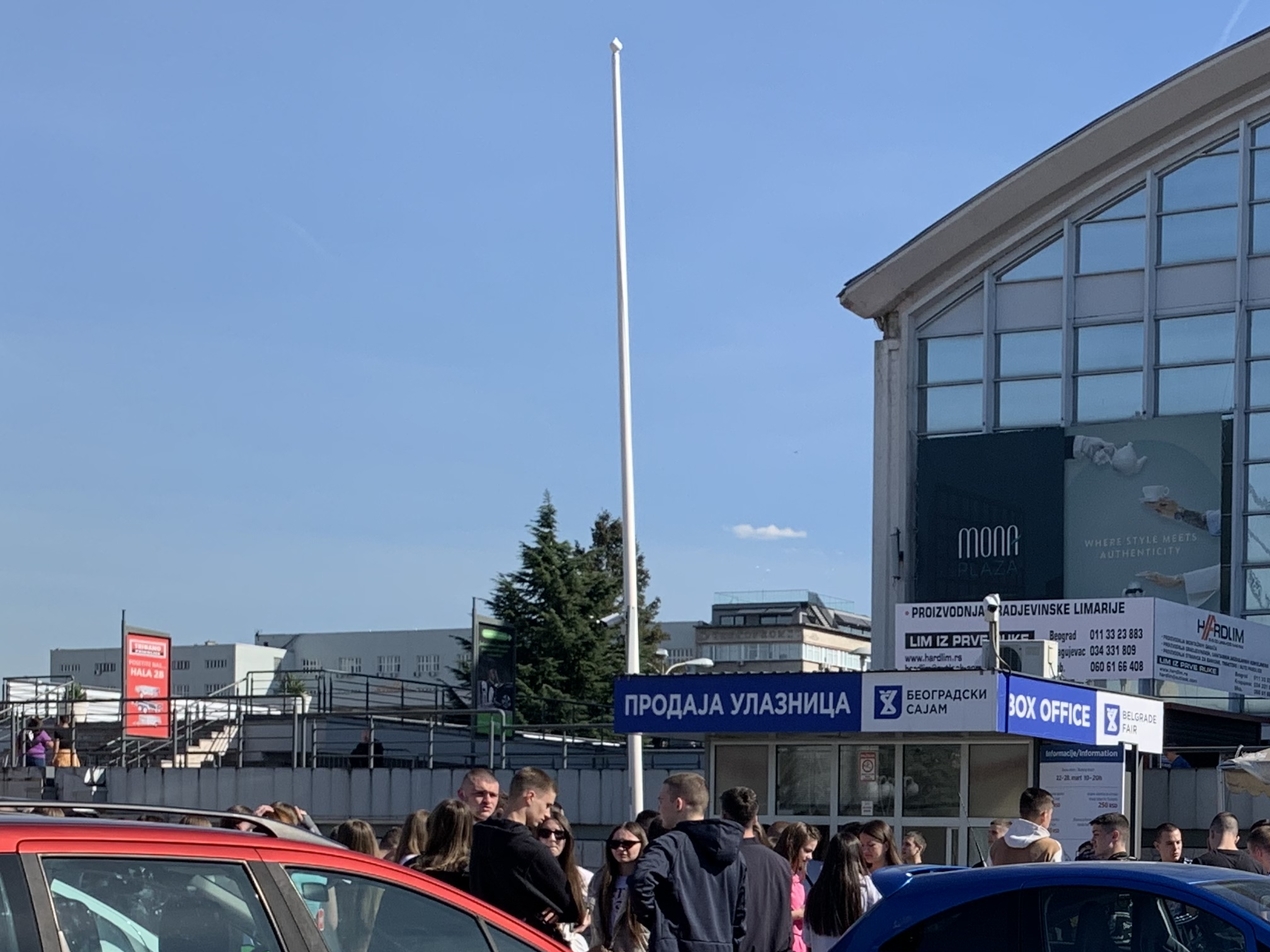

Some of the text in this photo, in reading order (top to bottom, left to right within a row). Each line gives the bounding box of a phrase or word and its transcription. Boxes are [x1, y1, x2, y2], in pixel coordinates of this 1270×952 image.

[1084, 532, 1198, 547] WHERE STYLE MEETS
[1099, 546, 1181, 559] AUTHENTICITY
[958, 560, 1018, 577] PLAZA
[911, 602, 1125, 618] PROIZVODNJA RADJEVINSKE LIMARIJE
[910, 635, 932, 647] LIM
[936, 635, 949, 647] IZ
[1049, 628, 1143, 643] Beograd 011 33 23 883
[1090, 645, 1104, 656] 034
[1106, 645, 1119, 655] 331
[1122, 645, 1136, 655] 809
[905, 653, 963, 662] www.hardlim.rs
[130, 667, 152, 678] HALA
[1091, 661, 1144, 672] 060 61 66 408
[1180, 661, 1198, 671] PRVE
[906, 688, 987, 701] БЕОГРАДСКИ
[624, 691, 851, 720] ПРОДАЈА УЛАЗНИЦА
[906, 703, 948, 715] САЈАМ
[1039, 698, 1091, 728] OFFICE
[1122, 710, 1157, 724] BELGRADE
[1122, 723, 1137, 735] FAIR
